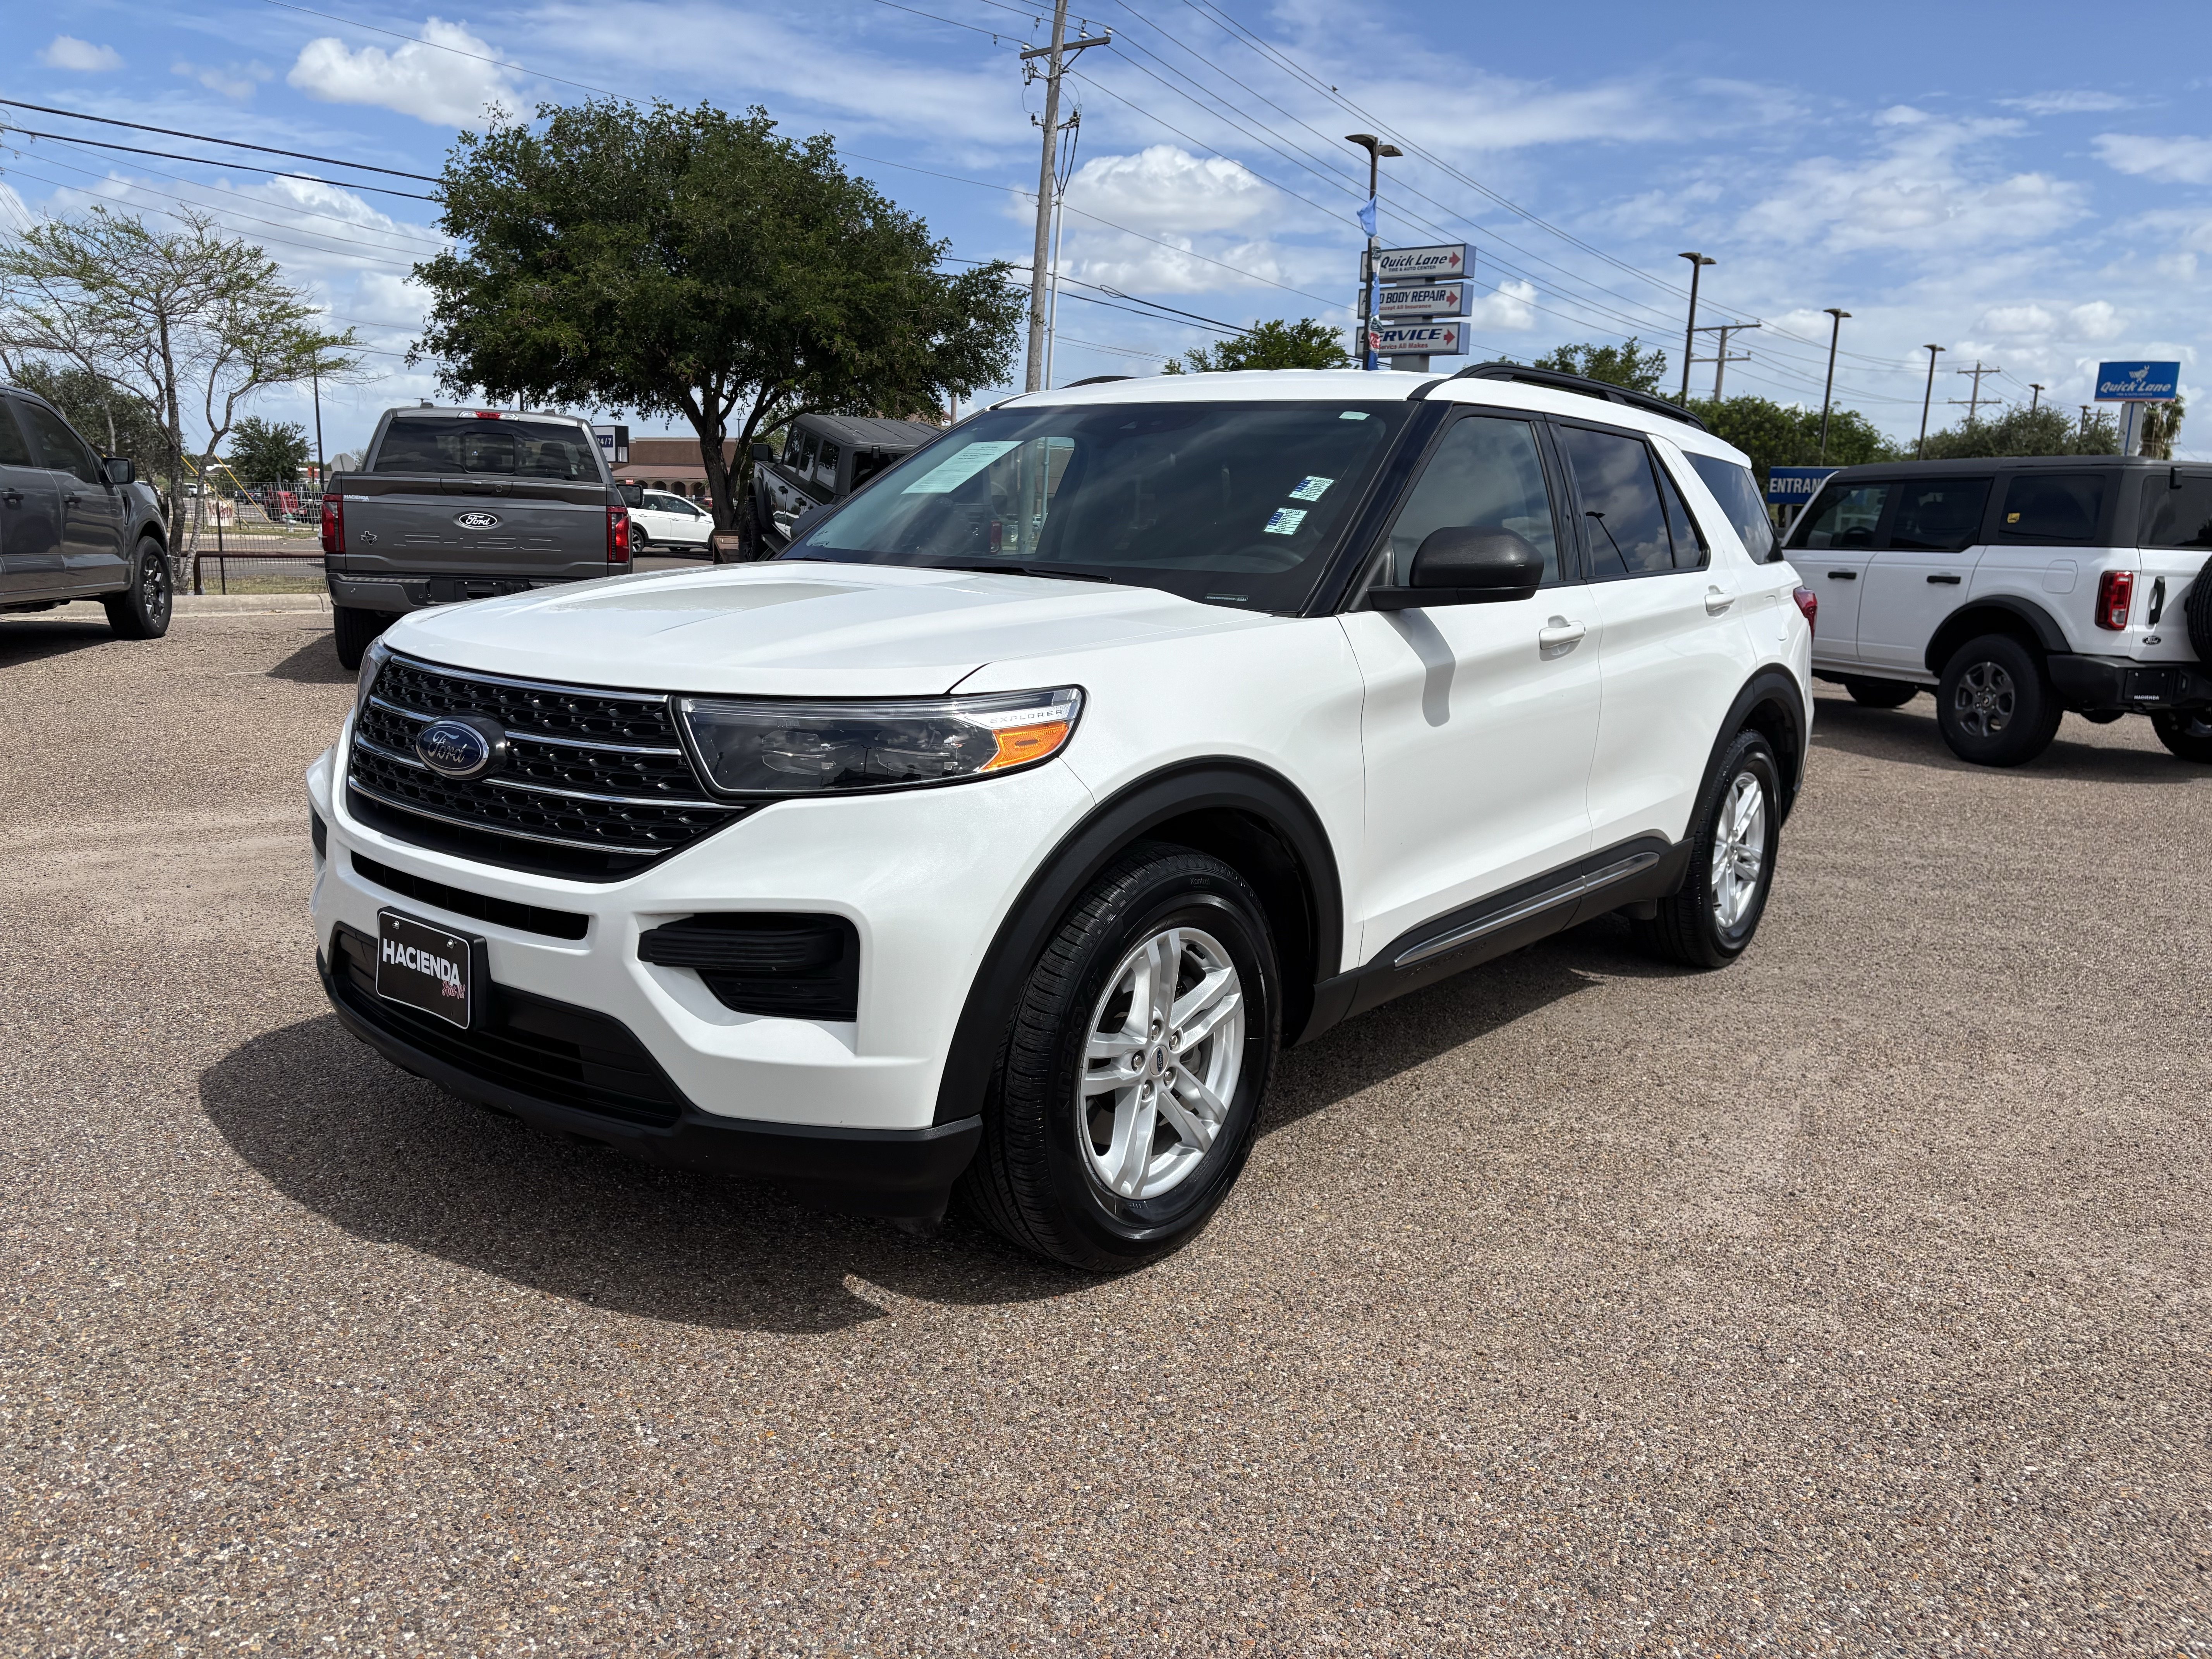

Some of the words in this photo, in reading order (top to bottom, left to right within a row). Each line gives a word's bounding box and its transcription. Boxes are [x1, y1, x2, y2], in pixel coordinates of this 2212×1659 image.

[1381, 255, 1414, 269] Quick
[1415, 254, 1448, 266] Lane
[1386, 291, 1411, 304] BODY
[1411, 290, 1446, 302] REPAIR
[2100, 381, 2137, 393] Quick
[2137, 381, 2171, 392] Lane
[465, 515, 490, 526] Ford
[990, 709, 1063, 724] EXPLORER
[428, 730, 467, 763] Ford
[383, 938, 460, 986] HACIENDA
[442, 980, 457, 997] Has
